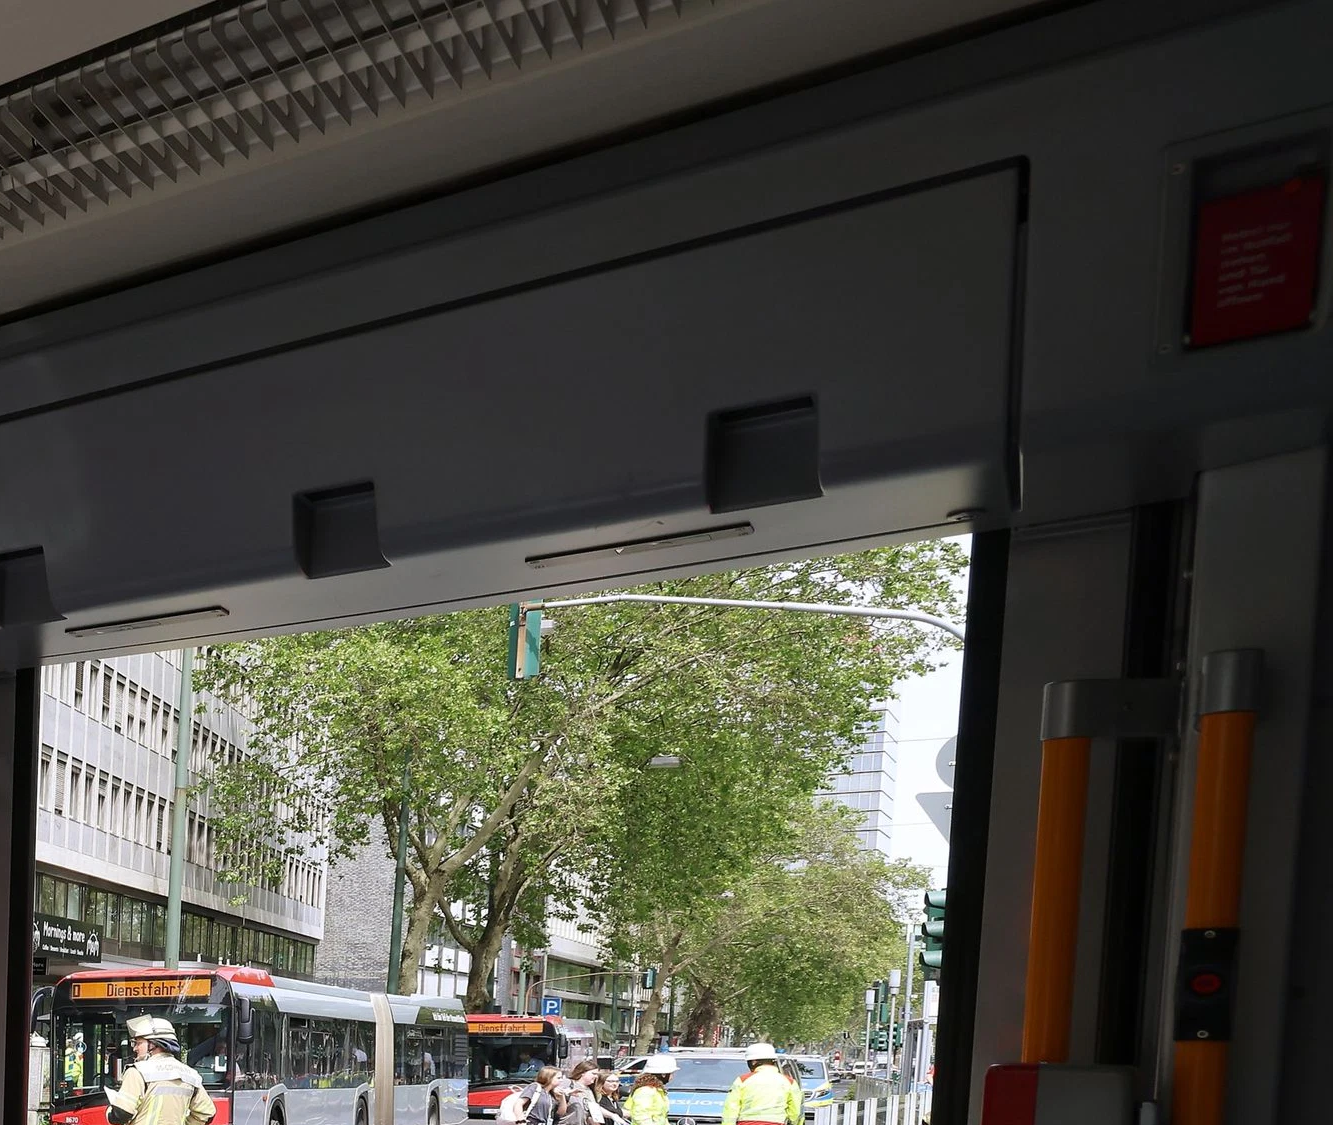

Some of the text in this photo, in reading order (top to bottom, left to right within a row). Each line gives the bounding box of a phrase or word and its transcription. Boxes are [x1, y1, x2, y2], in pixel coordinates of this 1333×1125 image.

[72, 930, 86, 943] more
[106, 981, 184, 998] Dienstfahrt
[478, 1022, 526, 1033] Dienstfahrt
